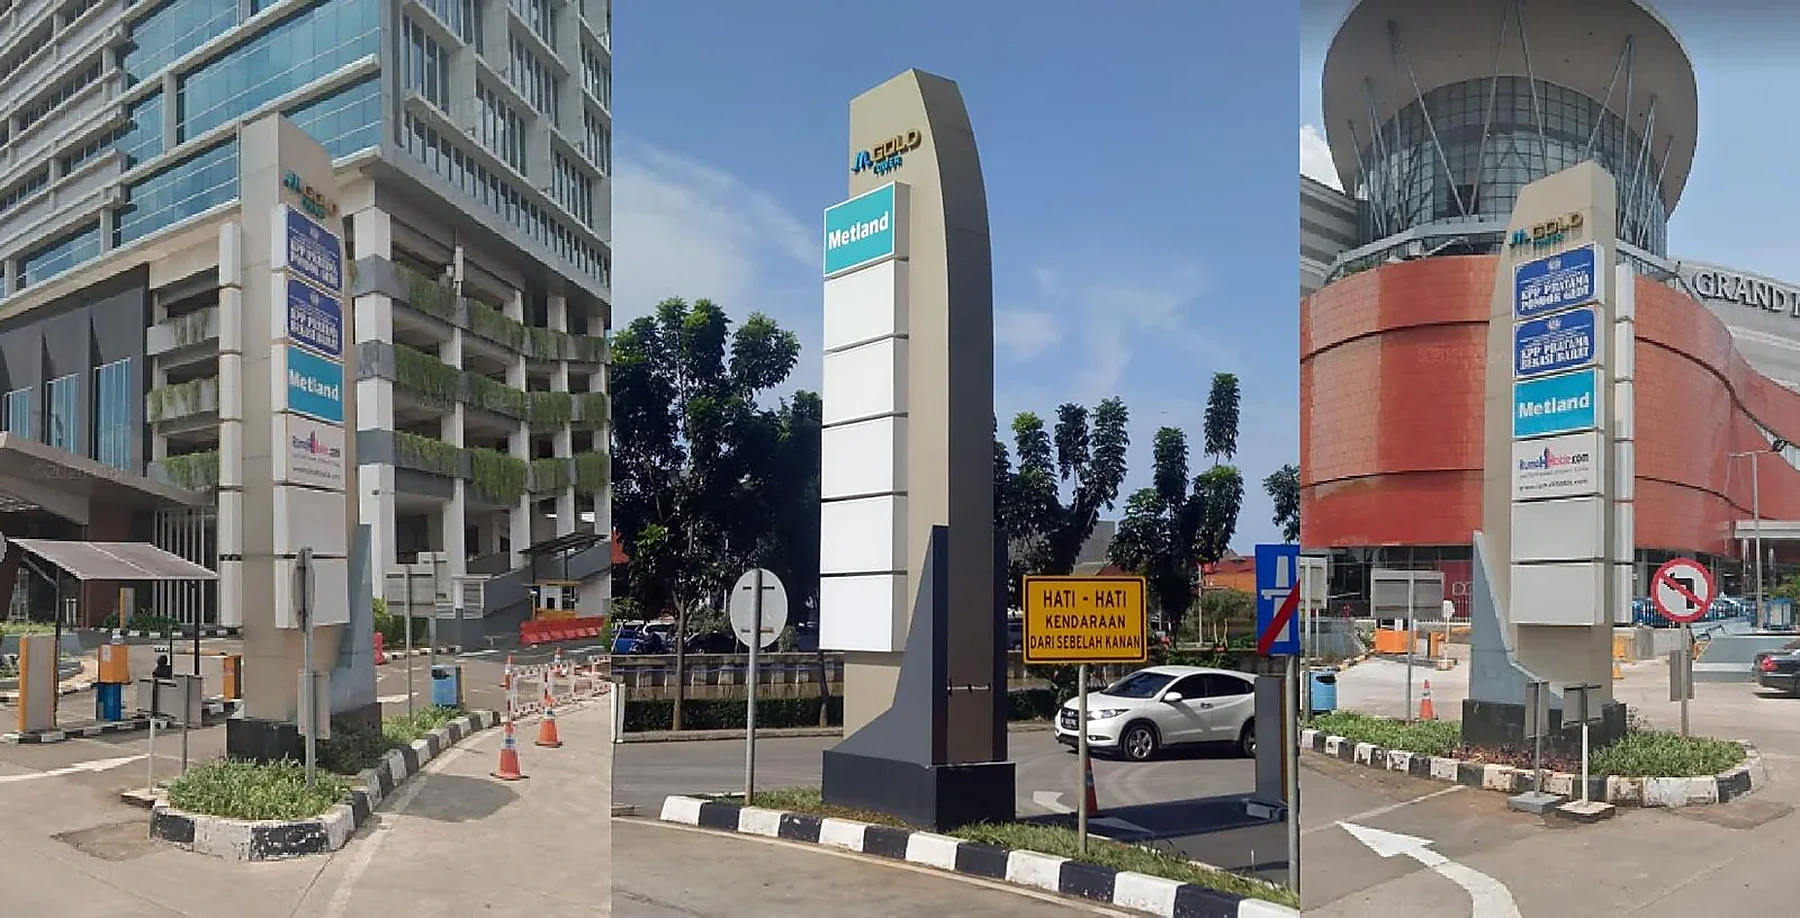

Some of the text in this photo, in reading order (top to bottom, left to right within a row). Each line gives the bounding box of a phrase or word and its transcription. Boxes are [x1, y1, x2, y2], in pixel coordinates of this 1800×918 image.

[874, 130, 922, 161] GOLD
[828, 211, 889, 250] Metland
[1533, 211, 1584, 238] GOLD
[1521, 286, 1541, 300] KPP
[1692, 271, 1787, 312] GRAND
[1521, 346, 1541, 359] KPP
[288, 369, 339, 401] Metland
[1519, 392, 1590, 418] Metland
[1043, 590, 1076, 608] HATI
[1095, 590, 1127, 608] HATI
[1045, 614, 1126, 629] KENDARAAN
[1030, 635, 1141, 649] DARI SEBELAH KANAN
